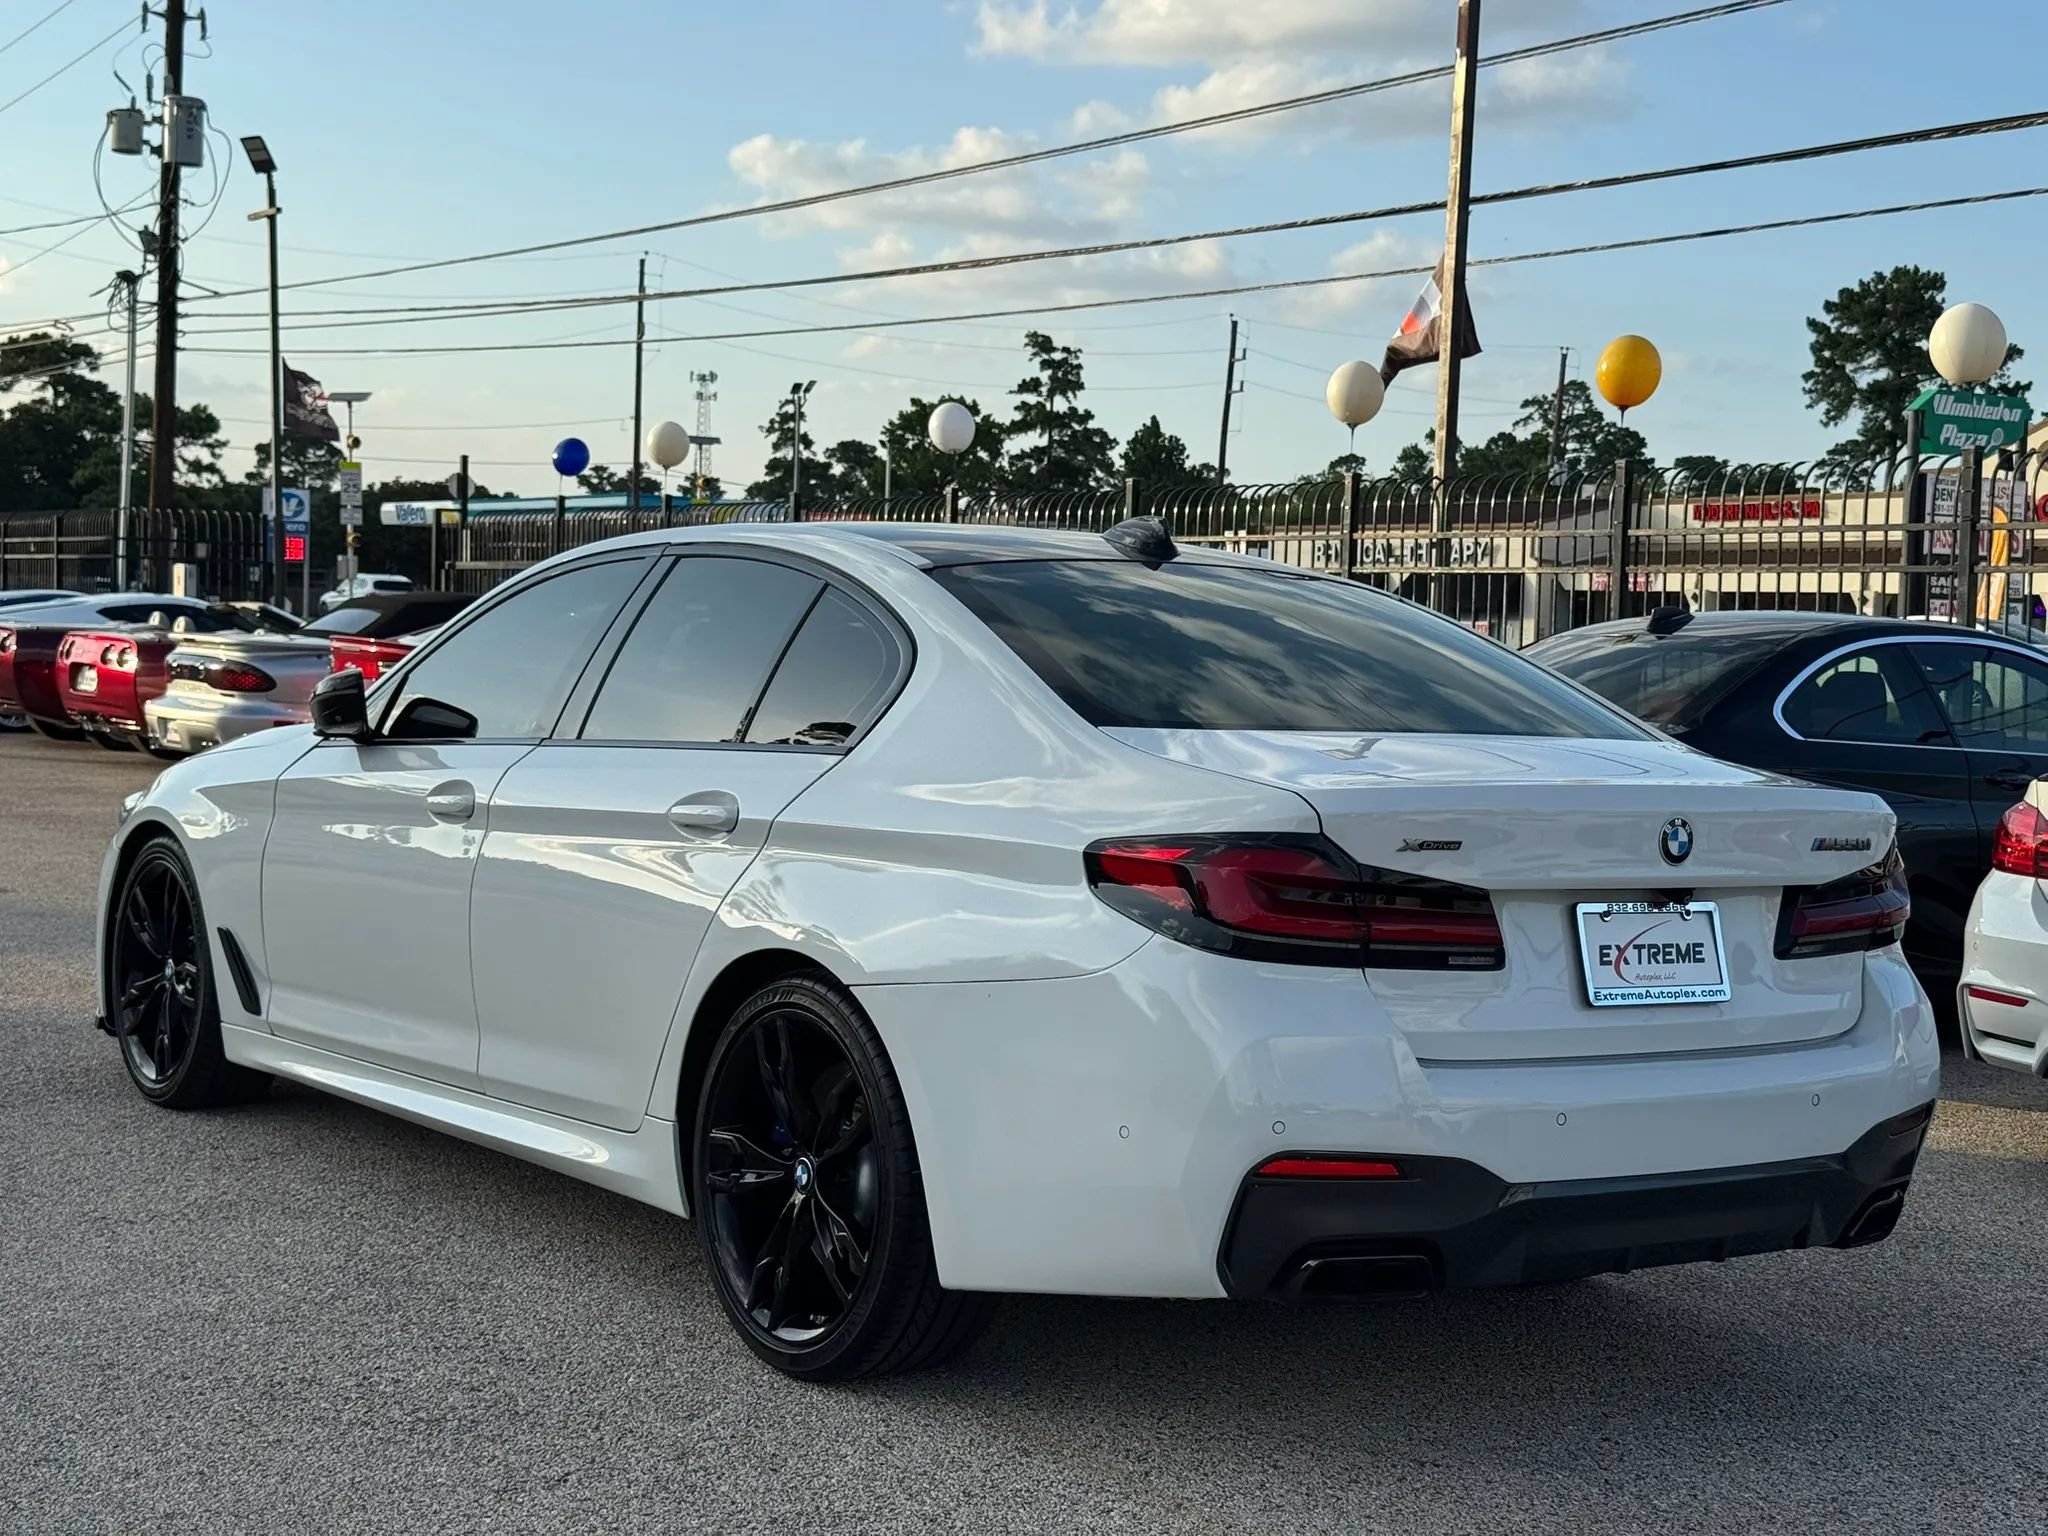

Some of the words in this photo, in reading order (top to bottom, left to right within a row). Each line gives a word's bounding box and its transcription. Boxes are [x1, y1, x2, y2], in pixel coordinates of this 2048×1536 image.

[1933, 393, 2022, 423] Wimbledon
[1940, 423, 1989, 447] Plaza
[343, 482, 360, 494] 25
[1599, 943, 1706, 966] EXTREME
[1594, 988, 1726, 1001] ExtremeAutoplex.com
